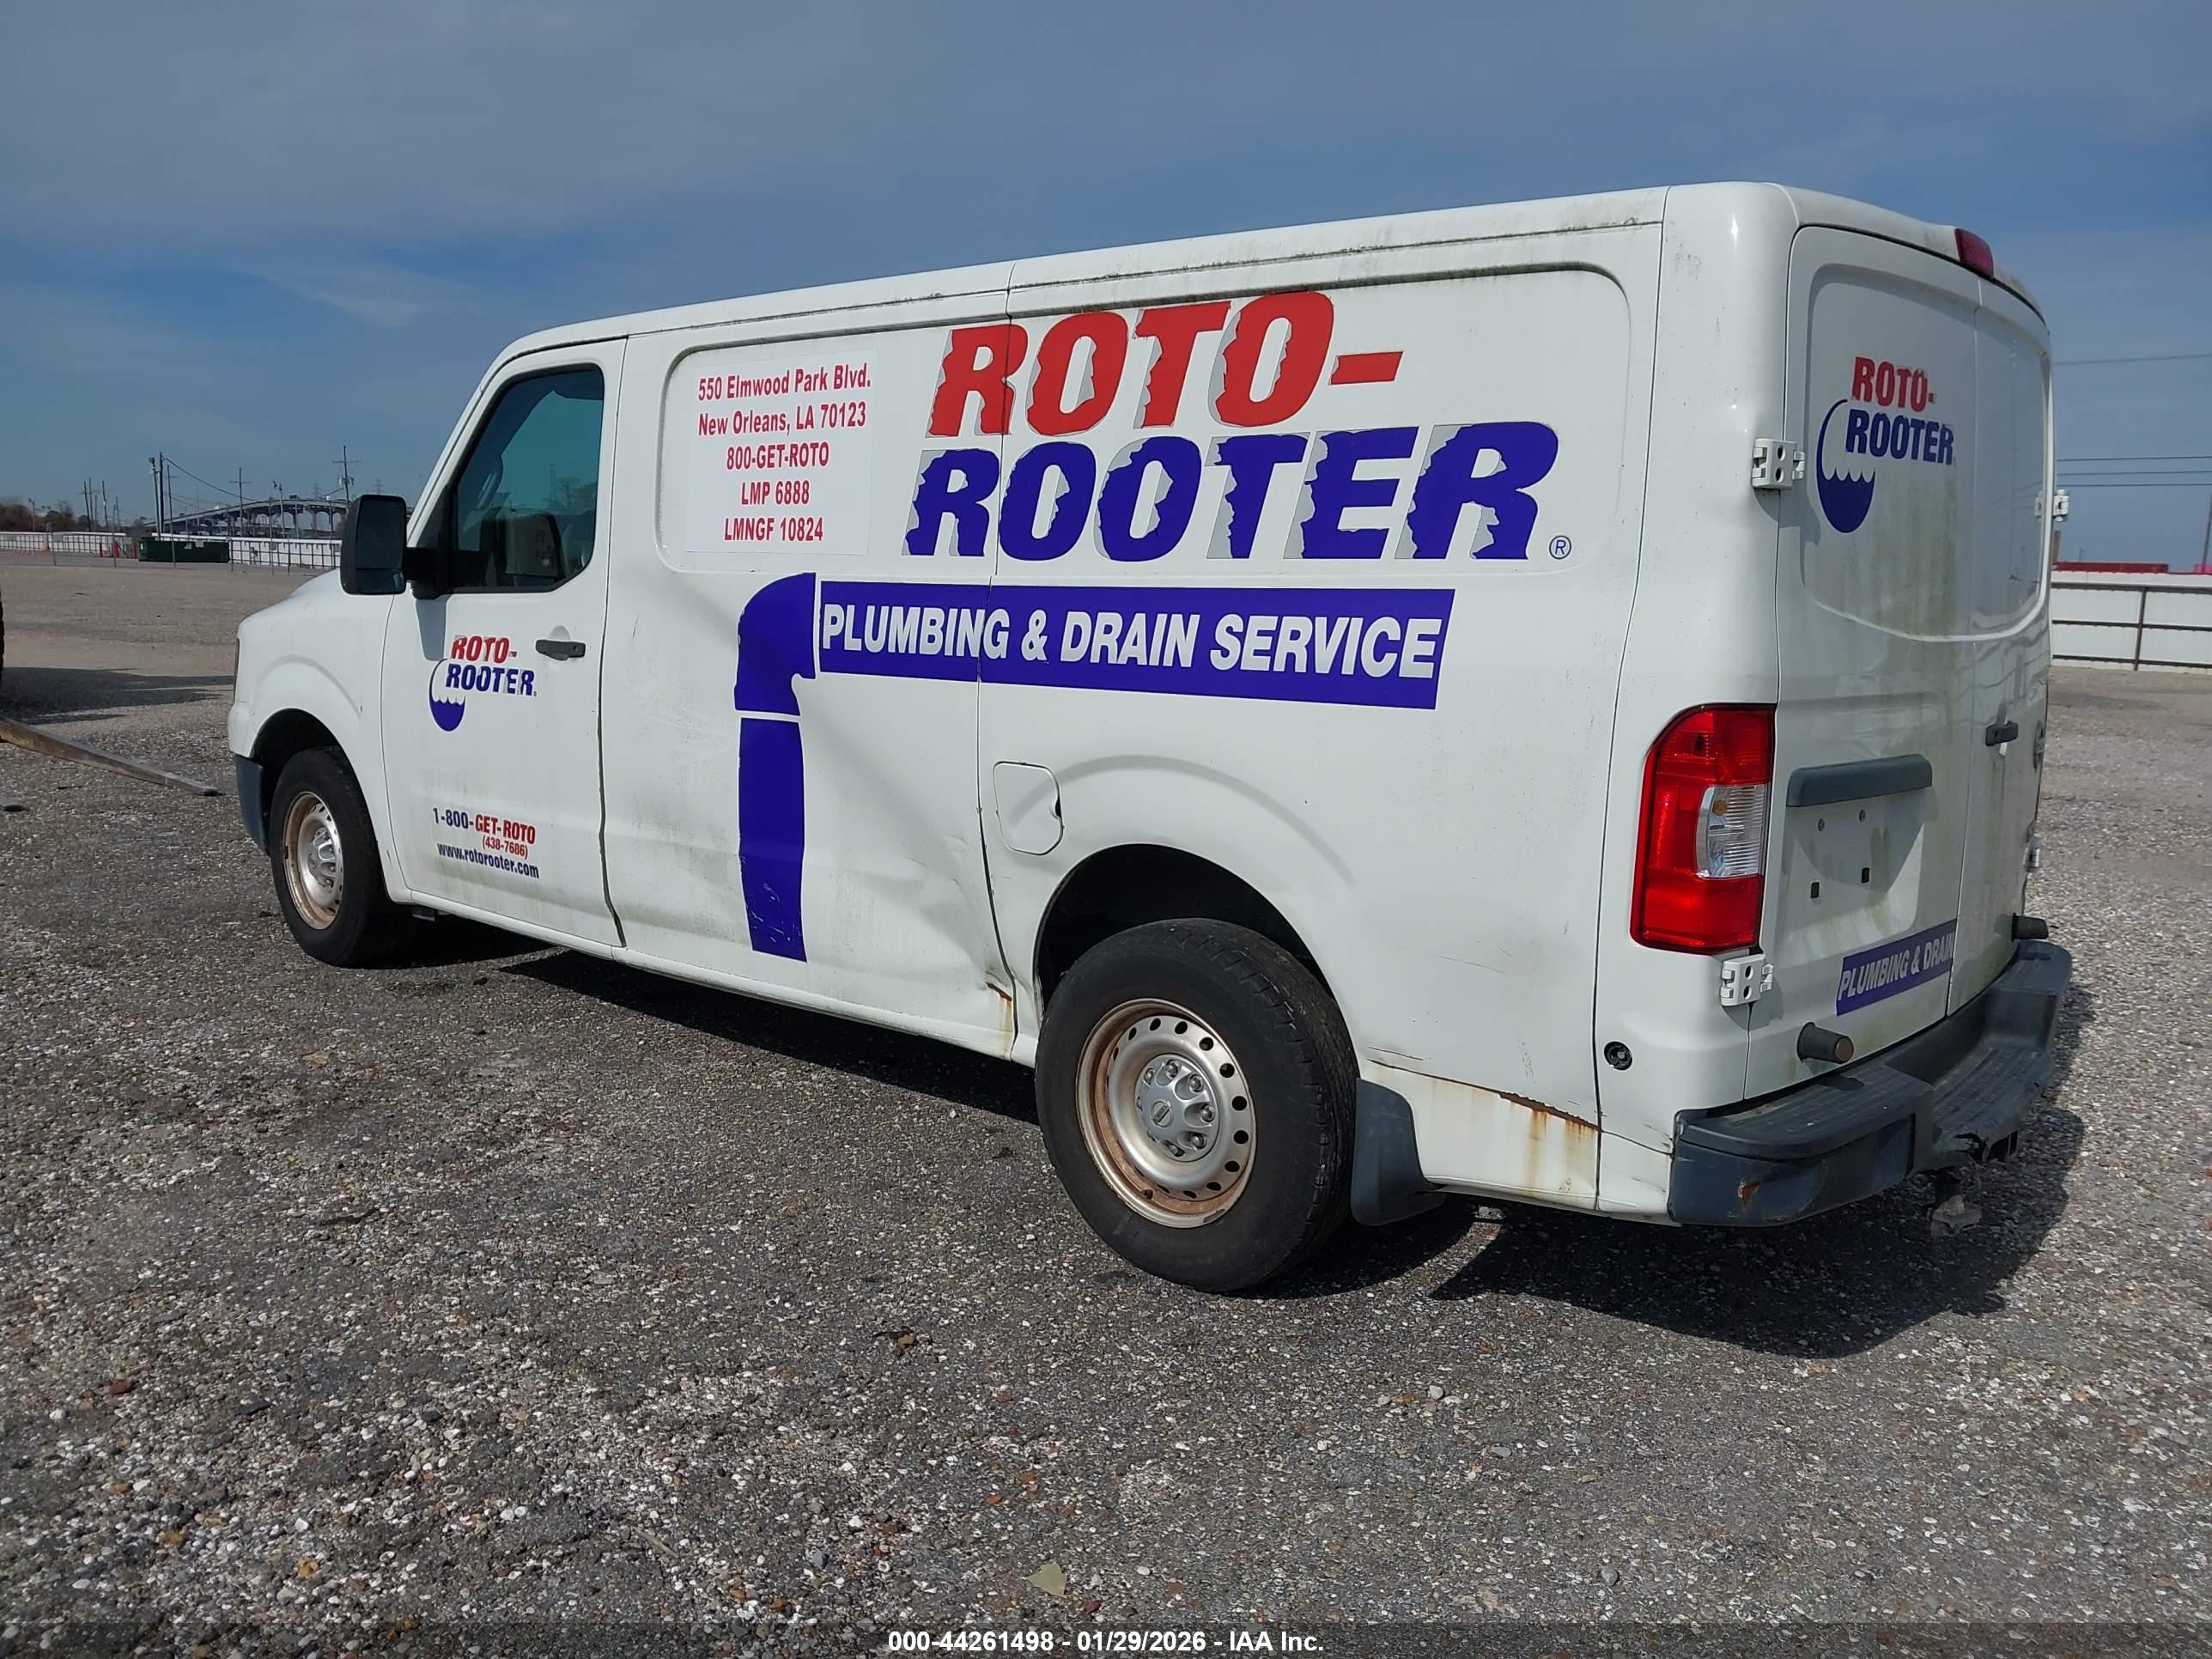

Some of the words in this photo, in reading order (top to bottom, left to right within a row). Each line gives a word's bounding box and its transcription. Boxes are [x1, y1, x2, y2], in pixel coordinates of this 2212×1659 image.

[698, 376, 723, 401] 550
[727, 370, 790, 399] Elmwood
[794, 367, 828, 392] Park
[833, 362, 871, 390] Blvd.
[925, 291, 1403, 438] ROTO-
[1852, 356, 1936, 412] ROTO-
[698, 413, 728, 435] New
[733, 410, 790, 436] Orleans,
[796, 405, 814, 430] LA
[820, 401, 866, 428] 70123
[1846, 408, 1954, 465] ROOTER
[726, 441, 830, 470] 800-GET-ROTO
[741, 481, 770, 505] LMP
[775, 480, 810, 505] 6888
[902, 421, 1559, 562] ROOTER
[724, 517, 775, 540] LMNGF
[780, 517, 823, 541] 10824
[451, 635, 517, 664] ROTO-
[823, 604, 1010, 659] PLUMBING
[1021, 609, 1048, 661] &
[1060, 610, 1200, 667] DRAIN
[1211, 613, 1443, 678] SERVICE
[446, 663, 535, 696] ROOTER
[433, 807, 536, 844] 1-800-GET-ROTO
[437, 843, 539, 878] www.rotorooter.com
[1838, 949, 1910, 1000] PLUMBING
[1911, 945, 1920, 975] &
